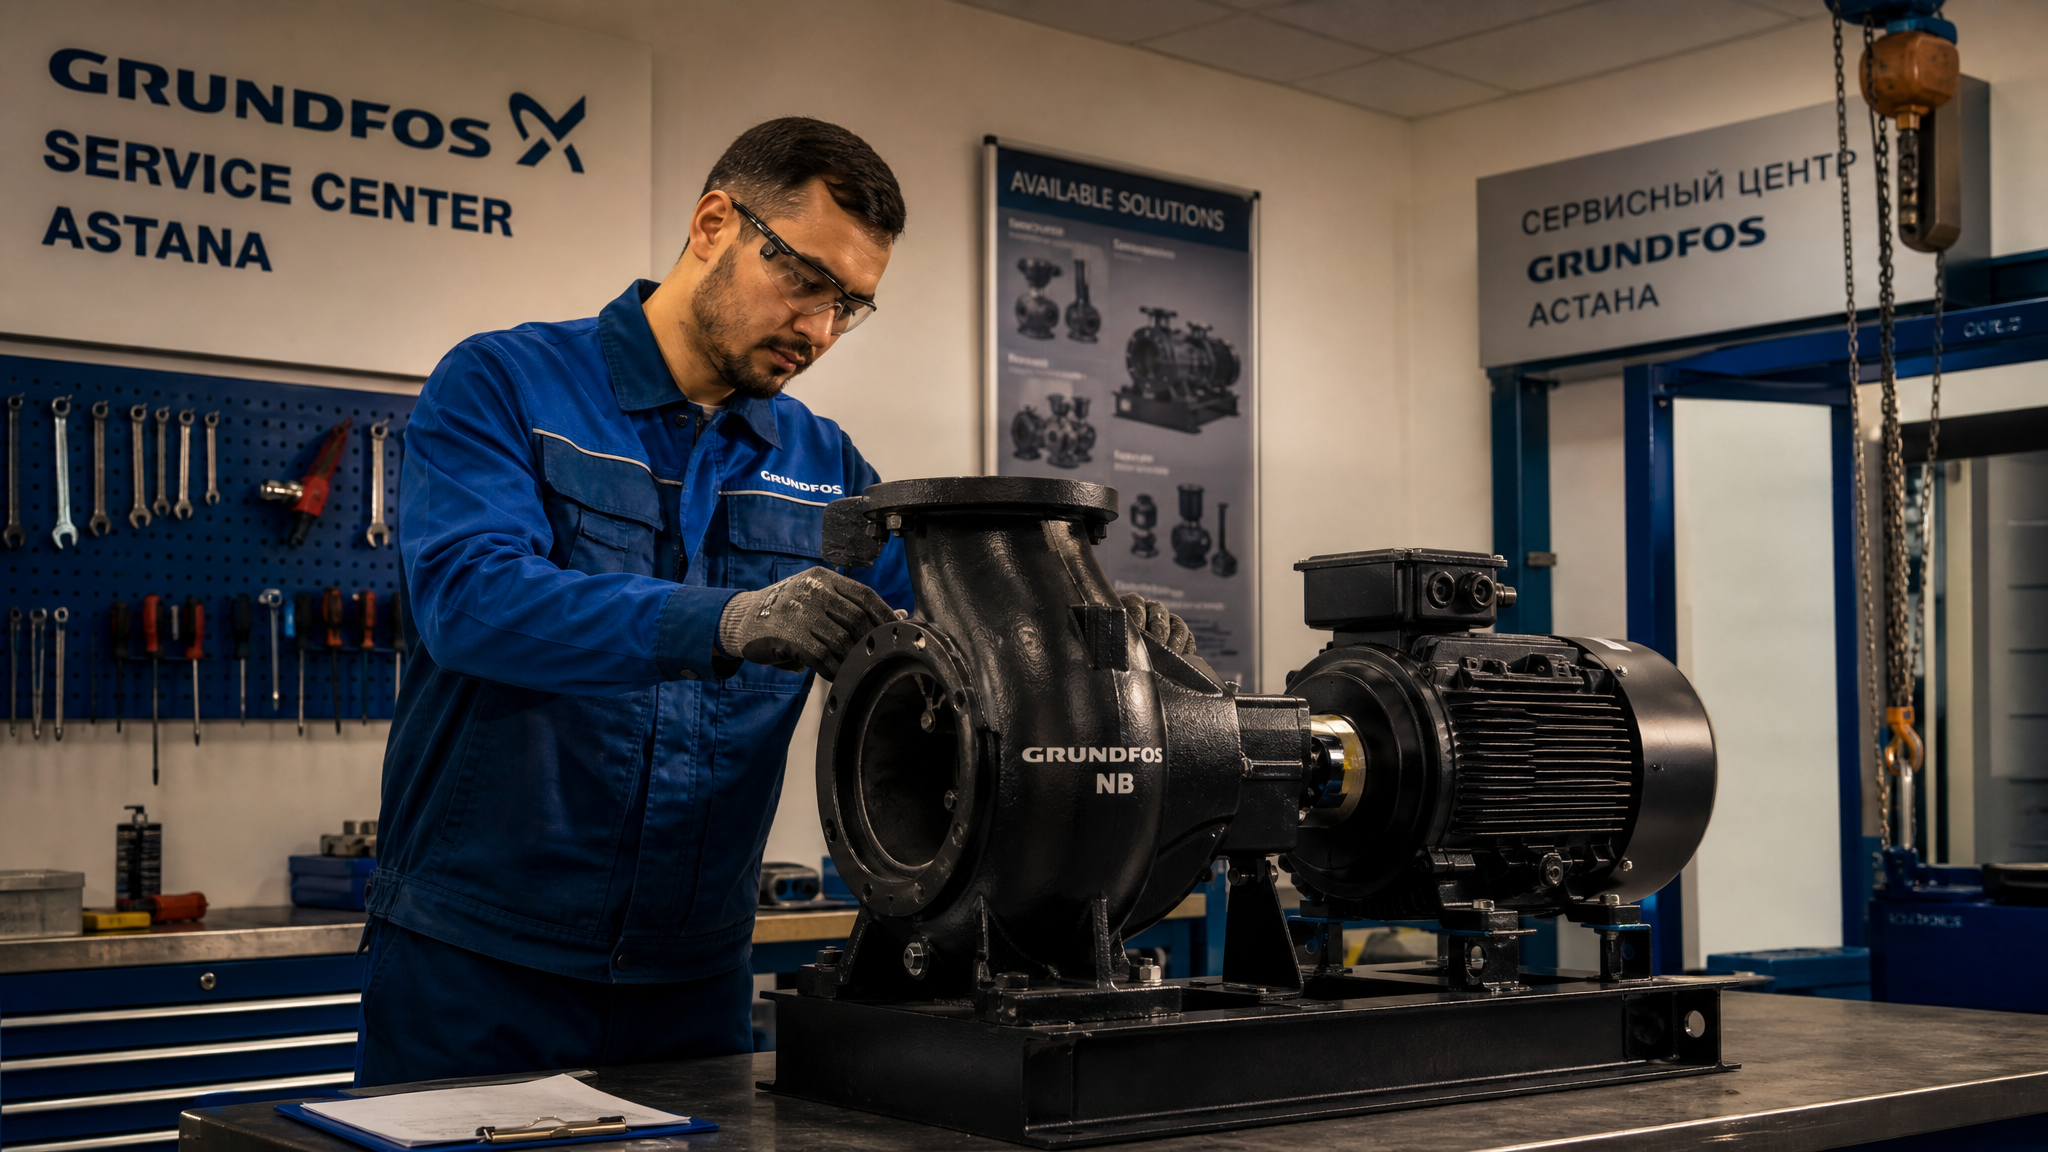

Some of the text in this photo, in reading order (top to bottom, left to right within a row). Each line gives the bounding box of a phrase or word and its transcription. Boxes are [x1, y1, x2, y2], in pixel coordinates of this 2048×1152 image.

[48, 47, 492, 159] GRUNDFOS
[43, 129, 514, 238] SERVICE CENTER
[1010, 170, 1225, 232] AVAILABLE SOLUTIONS
[1522, 150, 1857, 236] СЕРВИСНЫЙ ЦЕНТР
[42, 205, 273, 272] ASTANA
[1527, 216, 1766, 283] GRUNDFOS
[1528, 283, 1660, 328] АСТАНА
[760, 470, 843, 495] GRUNDFOS
[1021, 746, 1164, 763] GRUNDFOS
[1096, 772, 1135, 795] NB
